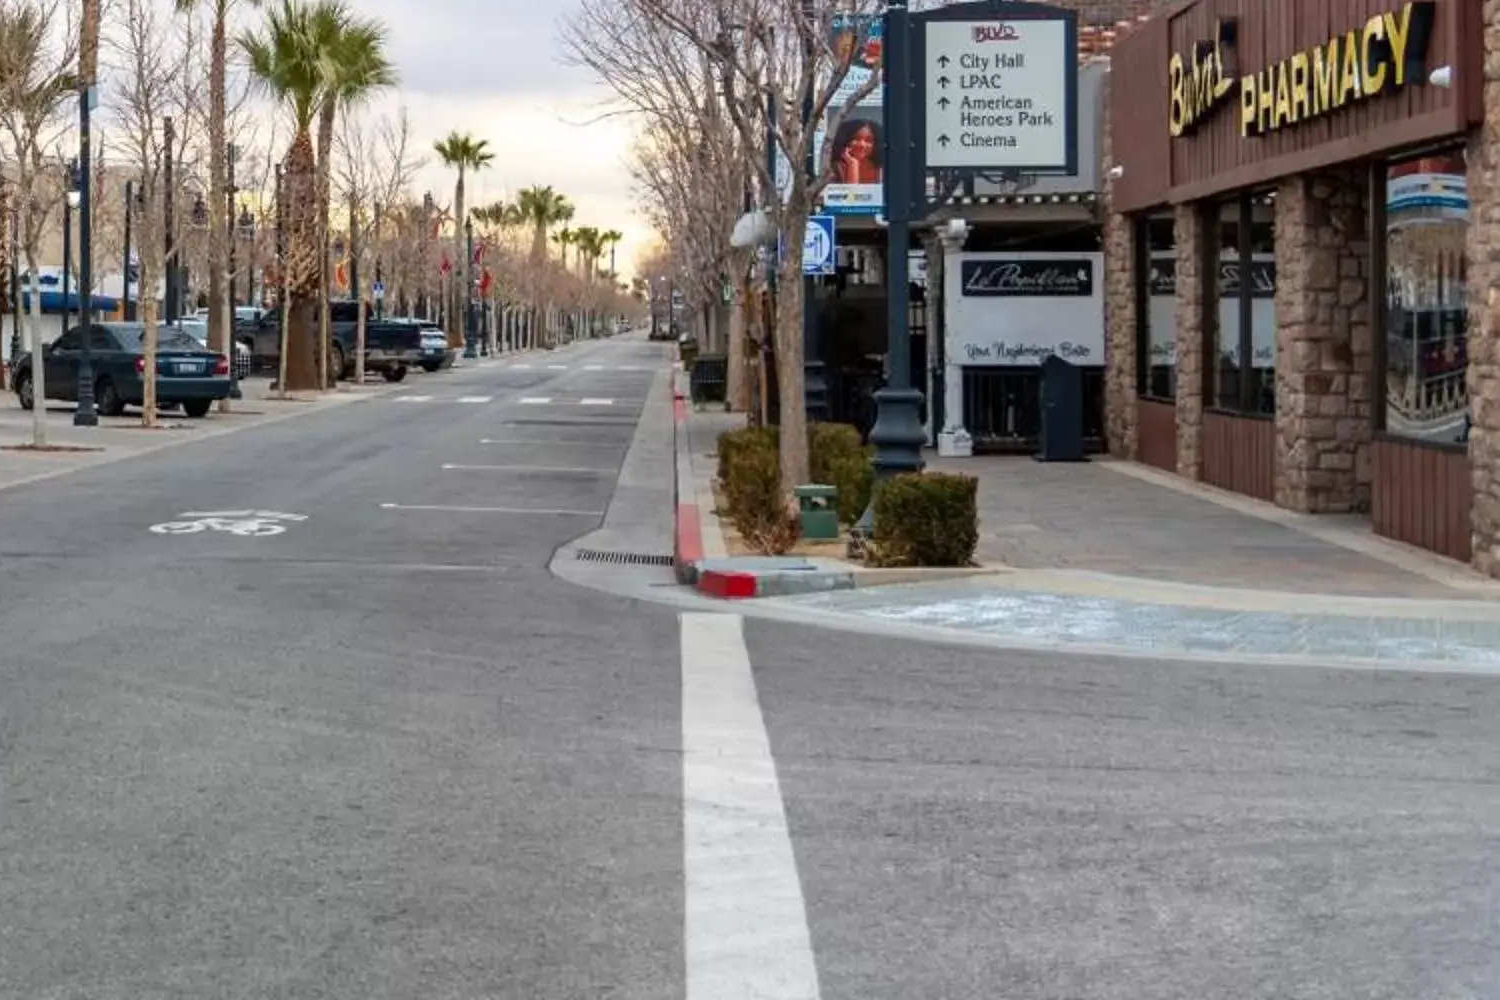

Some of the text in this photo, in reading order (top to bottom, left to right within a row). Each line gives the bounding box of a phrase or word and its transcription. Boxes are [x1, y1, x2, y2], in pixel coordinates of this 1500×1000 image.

[960, 53, 1024, 72] City Hall
[1240, 1, 1414, 138] PHARMACY
[960, 74, 1002, 89] LPAC
[960, 95, 1032, 109] American
[960, 111, 1053, 126] Heroes Park
[960, 132, 1017, 147] Cinema
